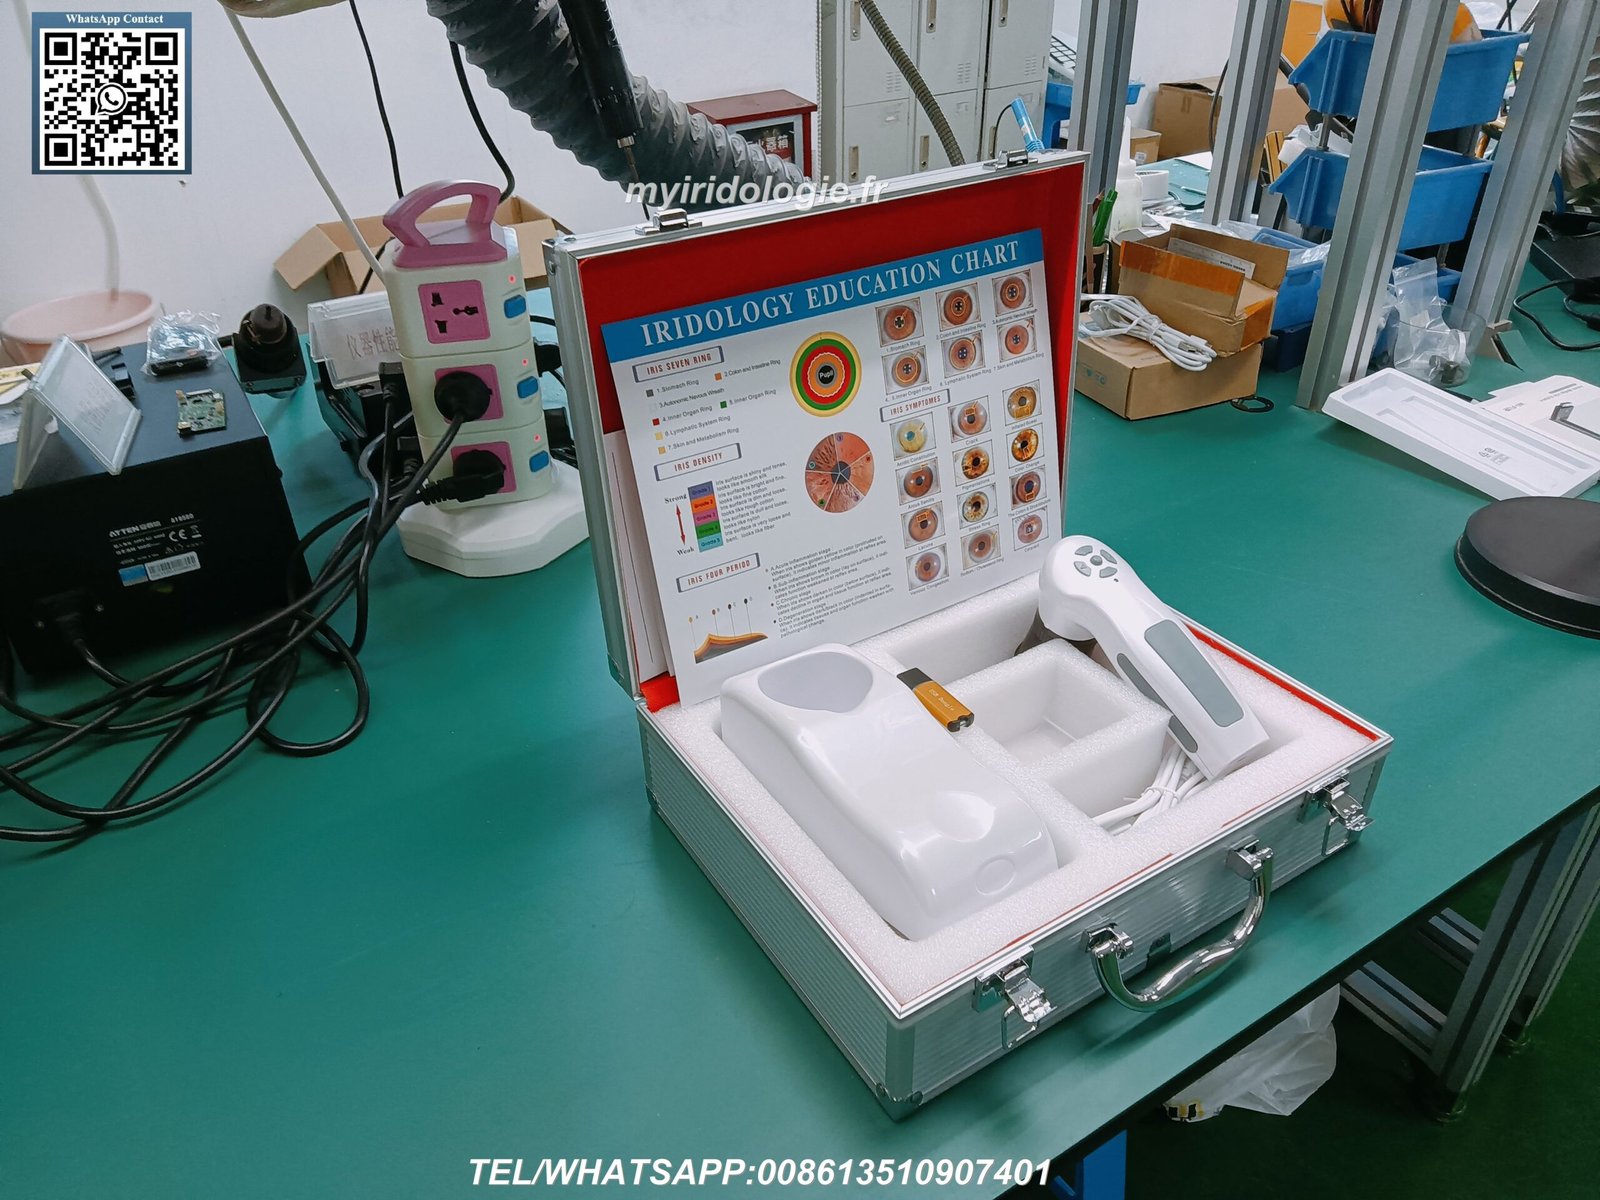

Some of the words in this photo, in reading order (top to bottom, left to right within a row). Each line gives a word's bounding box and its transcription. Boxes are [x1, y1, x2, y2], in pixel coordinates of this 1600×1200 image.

[640, 292, 794, 347] IRIDOLOGY
[805, 259, 942, 310] EDUCATION
[951, 240, 1019, 275] CHART
[647, 364, 663, 375] IRIS
[666, 358, 690, 370] SEVEN
[693, 353, 711, 364] RING
[819, 370, 834, 379] Pupil
[748, 392, 764, 400] Organ
[891, 406, 903, 415] IRIS
[905, 395, 940, 411] SYMPTOMES
[682, 409, 700, 417] Organ
[674, 461, 690, 472] IRIS
[693, 452, 722, 467] DENSITY
[724, 475, 743, 483] surface
[726, 487, 745, 496] surface
[664, 494, 687, 504] Strong
[729, 499, 747, 508] surface
[731, 512, 750, 521] surface
[733, 525, 752, 534] surface
[677, 546, 694, 555] Weak
[688, 575, 703, 585] IRIS
[706, 568, 723, 580] FOUR
[726, 560, 750, 573] PERIOD
